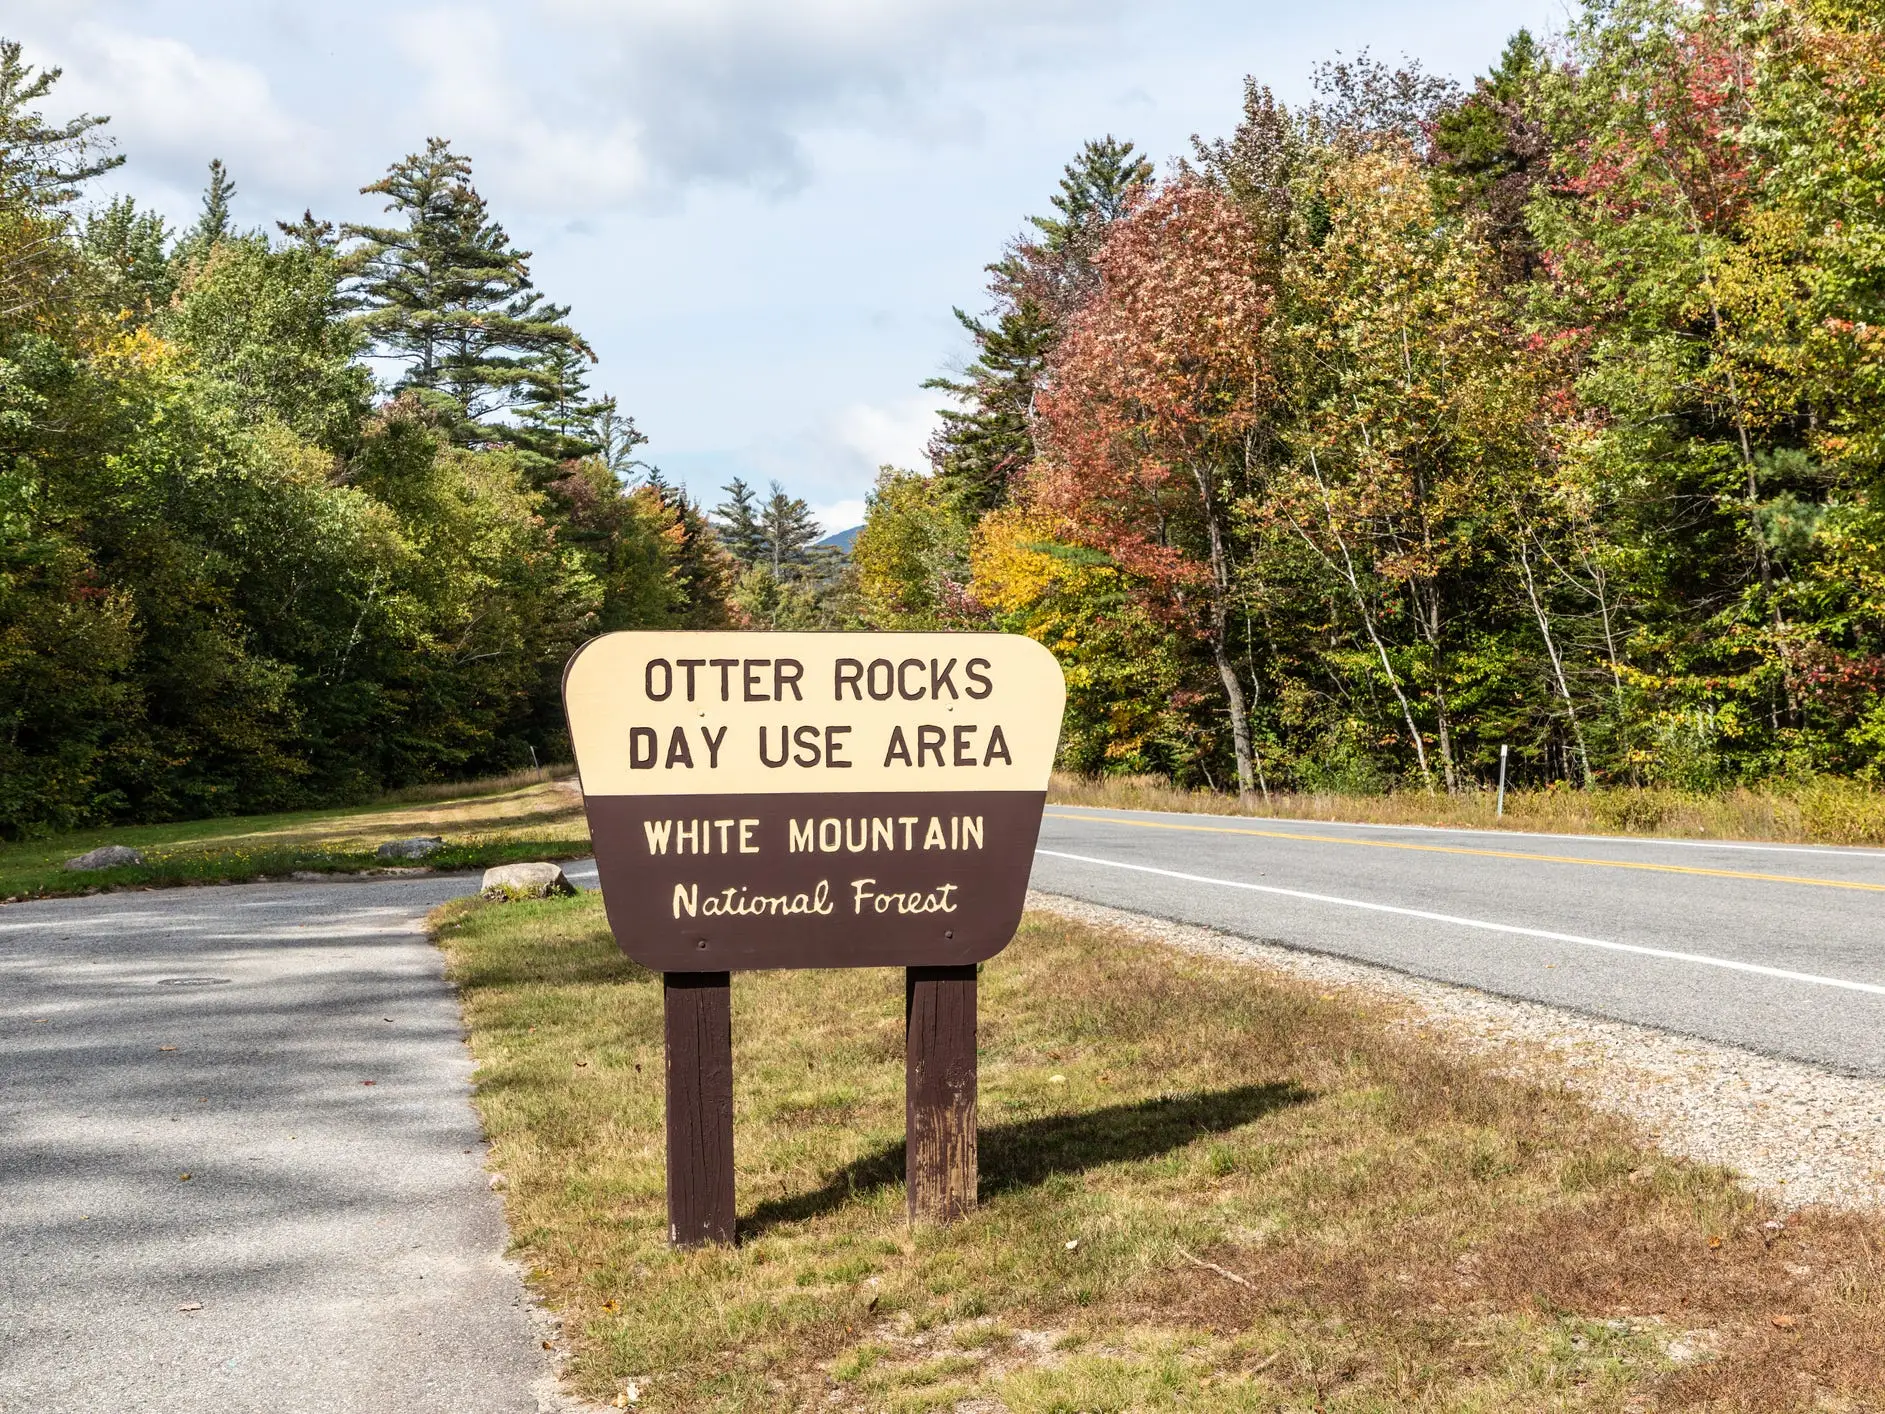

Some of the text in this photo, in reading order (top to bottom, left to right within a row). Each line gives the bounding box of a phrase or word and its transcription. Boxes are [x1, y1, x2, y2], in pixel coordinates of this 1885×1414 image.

[645, 657, 993, 702] OTTER ROCKS
[629, 724, 1012, 770] DAY USE AREA
[643, 815, 984, 856] WHITE MOUNTAIN
[672, 878, 959, 920] National Forest
